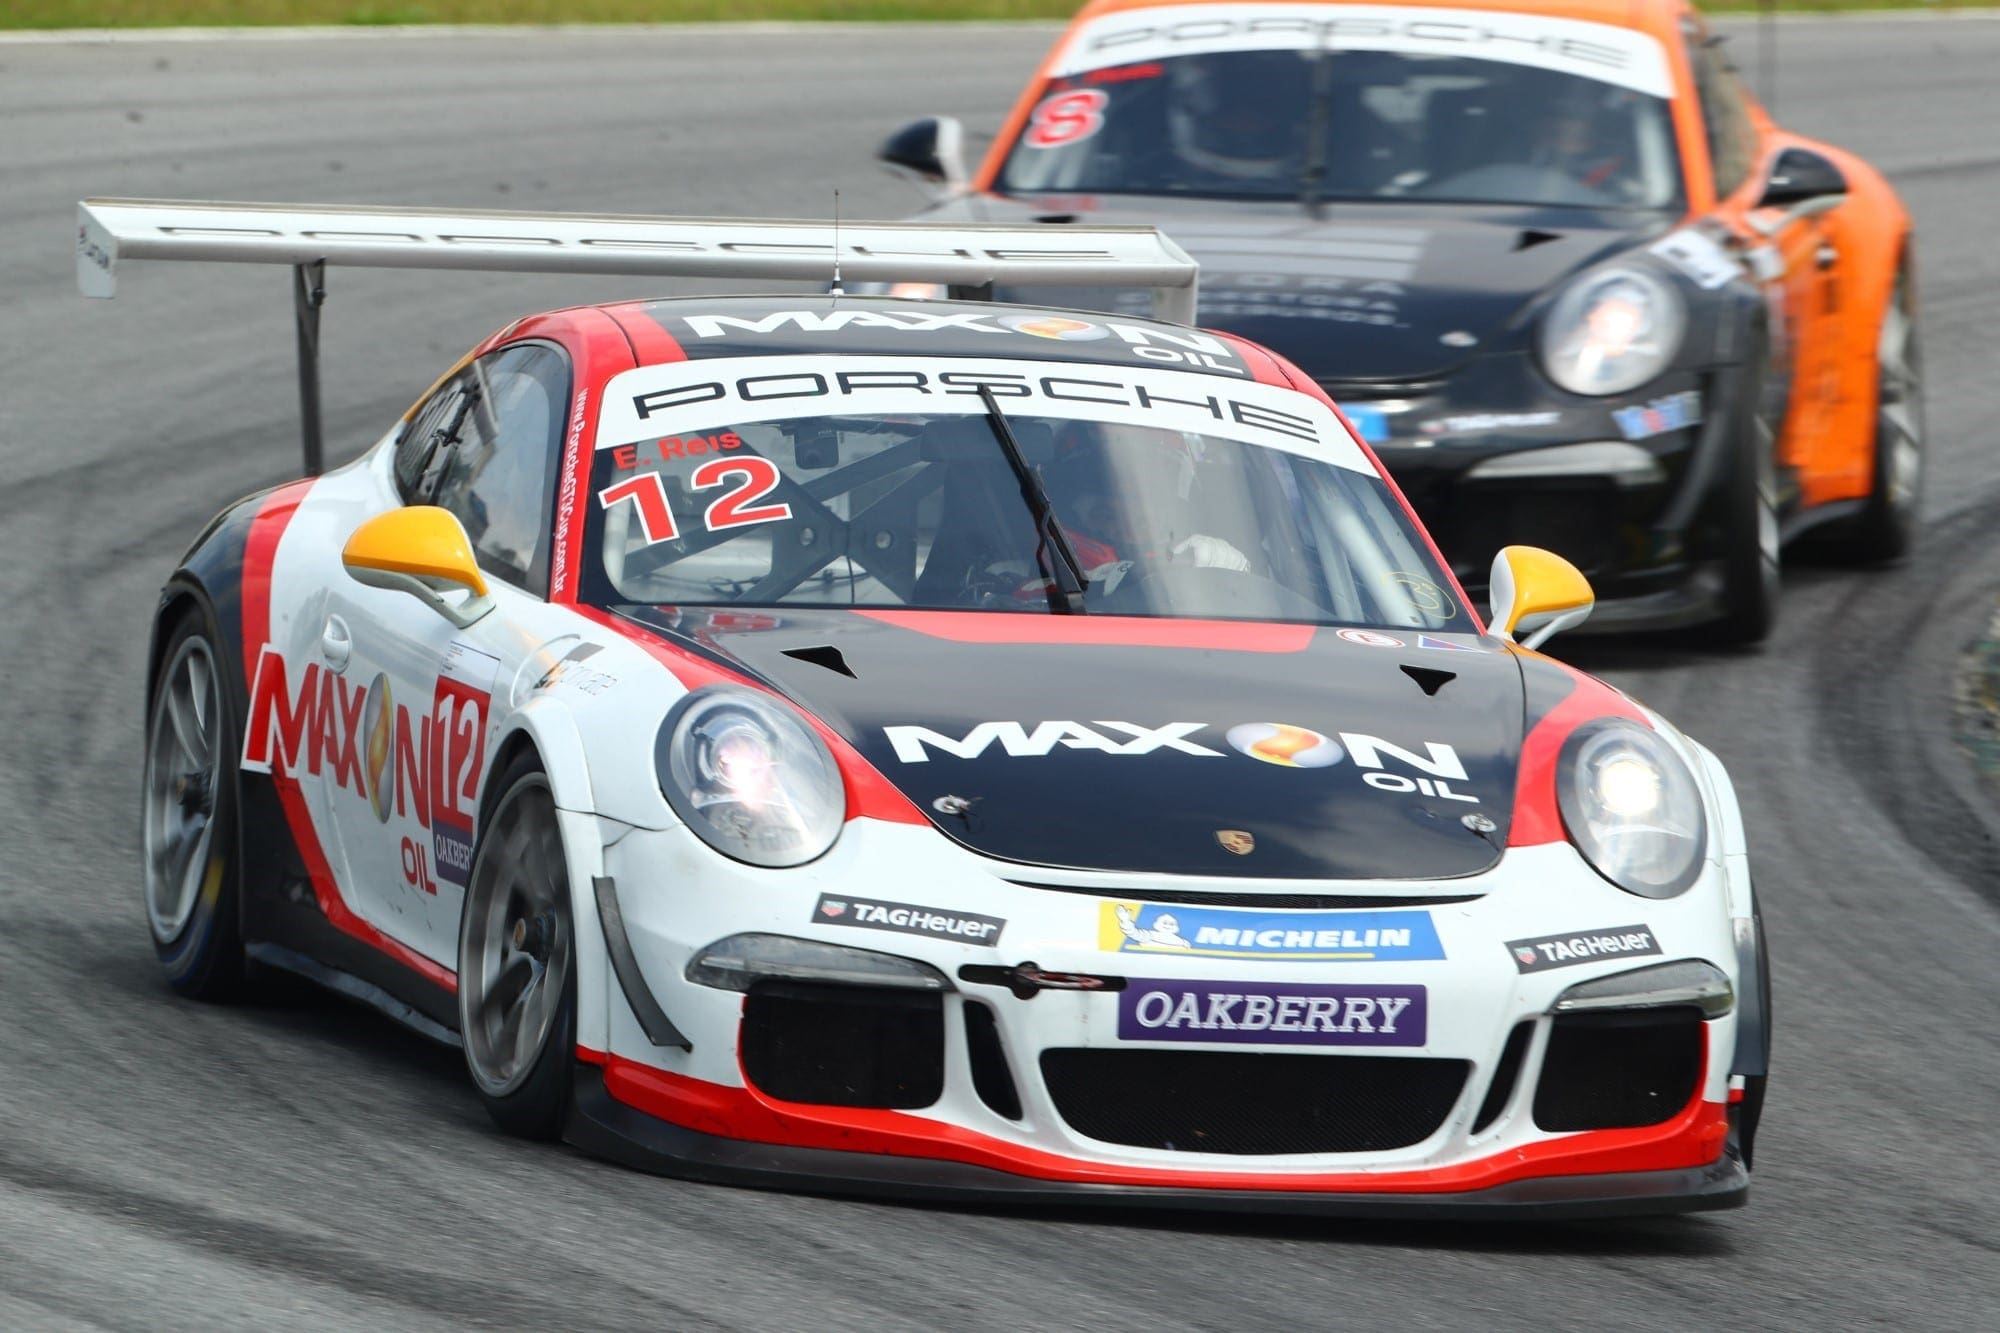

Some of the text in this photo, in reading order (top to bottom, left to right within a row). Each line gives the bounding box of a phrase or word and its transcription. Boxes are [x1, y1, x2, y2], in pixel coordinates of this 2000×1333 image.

[1132, 346, 1244, 375] OIL
[633, 371, 1320, 444] PORSCHE
[658, 431, 742, 460] Reis
[598, 455, 794, 545] 12
[436, 693, 480, 815] 12
[1362, 772, 1480, 803] OIL
[401, 836, 437, 896] OIL
[1195, 925, 1411, 949] MICHELIN
[1136, 990, 1410, 1035] OAKBERRY
